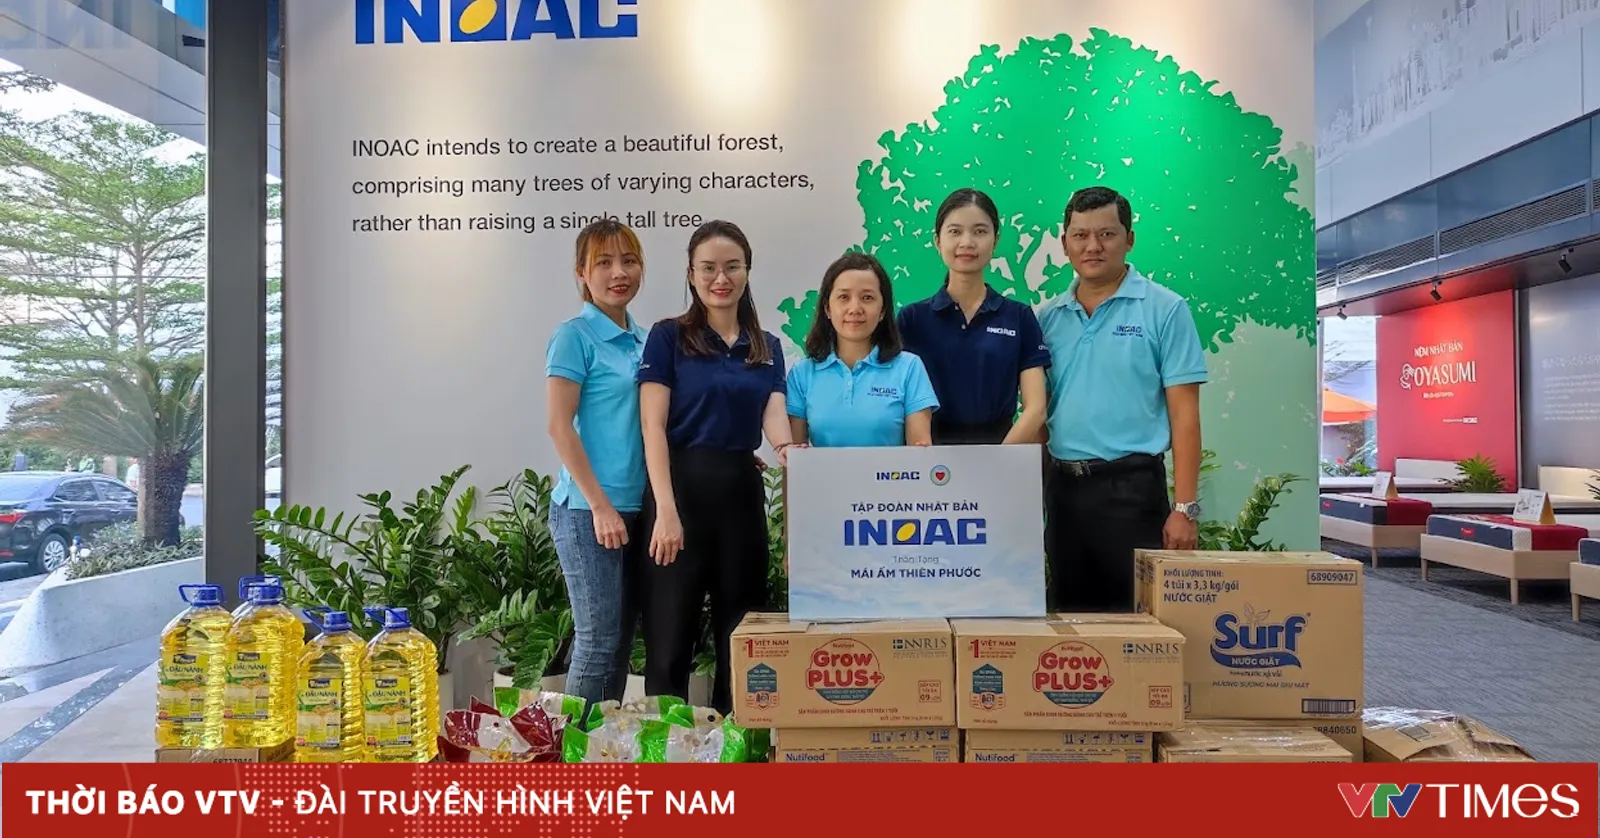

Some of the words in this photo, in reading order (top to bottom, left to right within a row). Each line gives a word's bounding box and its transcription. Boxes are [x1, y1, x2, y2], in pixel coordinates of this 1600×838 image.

[355, 0, 638, 44] INOAC
[352, 138, 420, 157] INOAC
[426, 137, 501, 156] intends
[508, 137, 528, 154] to
[533, 137, 597, 154] create
[604, 138, 617, 152] a
[623, 134, 711, 152] beautiful
[717, 133, 784, 153] forest,
[352, 176, 464, 198] comprising
[471, 178, 527, 197] many
[533, 175, 584, 192] trees
[591, 172, 611, 191] of
[617, 172, 692, 194] varying
[698, 171, 815, 191] characters,
[352, 214, 412, 232] rather
[417, 214, 461, 232] than
[468, 212, 536, 234] raising
[542, 216, 556, 230] a
[625, 210, 656, 229] tall
[662, 211, 703, 228] tree
[986, 326, 1016, 336] INOAC
[1414, 360, 1476, 386] OYASUMI
[871, 386, 897, 395] INOAC
[876, 471, 920, 480] INOAC
[851, 501, 874, 514] TẬP
[878, 501, 913, 512] ĐOÀN
[916, 501, 949, 514] NHẬT
[952, 500, 978, 511] BẢN
[844, 518, 987, 546] INOAC
[851, 567, 874, 578] MÁI
[876, 566, 896, 578] ẤM
[899, 566, 936, 578] THIÊN
[939, 566, 982, 578] PHƯỚC
[1310, 572, 1354, 582] 68909047
[1164, 580, 1169, 589] 4
[1172, 580, 1184, 590] túi
[1194, 580, 1208, 591] 3,3
[1209, 580, 1240, 592] kg/gói
[1164, 592, 1193, 602] NƯỚC
[1214, 613, 1307, 652] Surf
[813, 650, 873, 668] Grow
[1040, 652, 1102, 670] Grow
[1232, 655, 1257, 665] NƯỚC
[808, 669, 882, 688] PLUS+
[1035, 672, 1112, 690] PLUS+
[786, 753, 825, 762] Nutifood
[975, 752, 1016, 762] Nutifood
